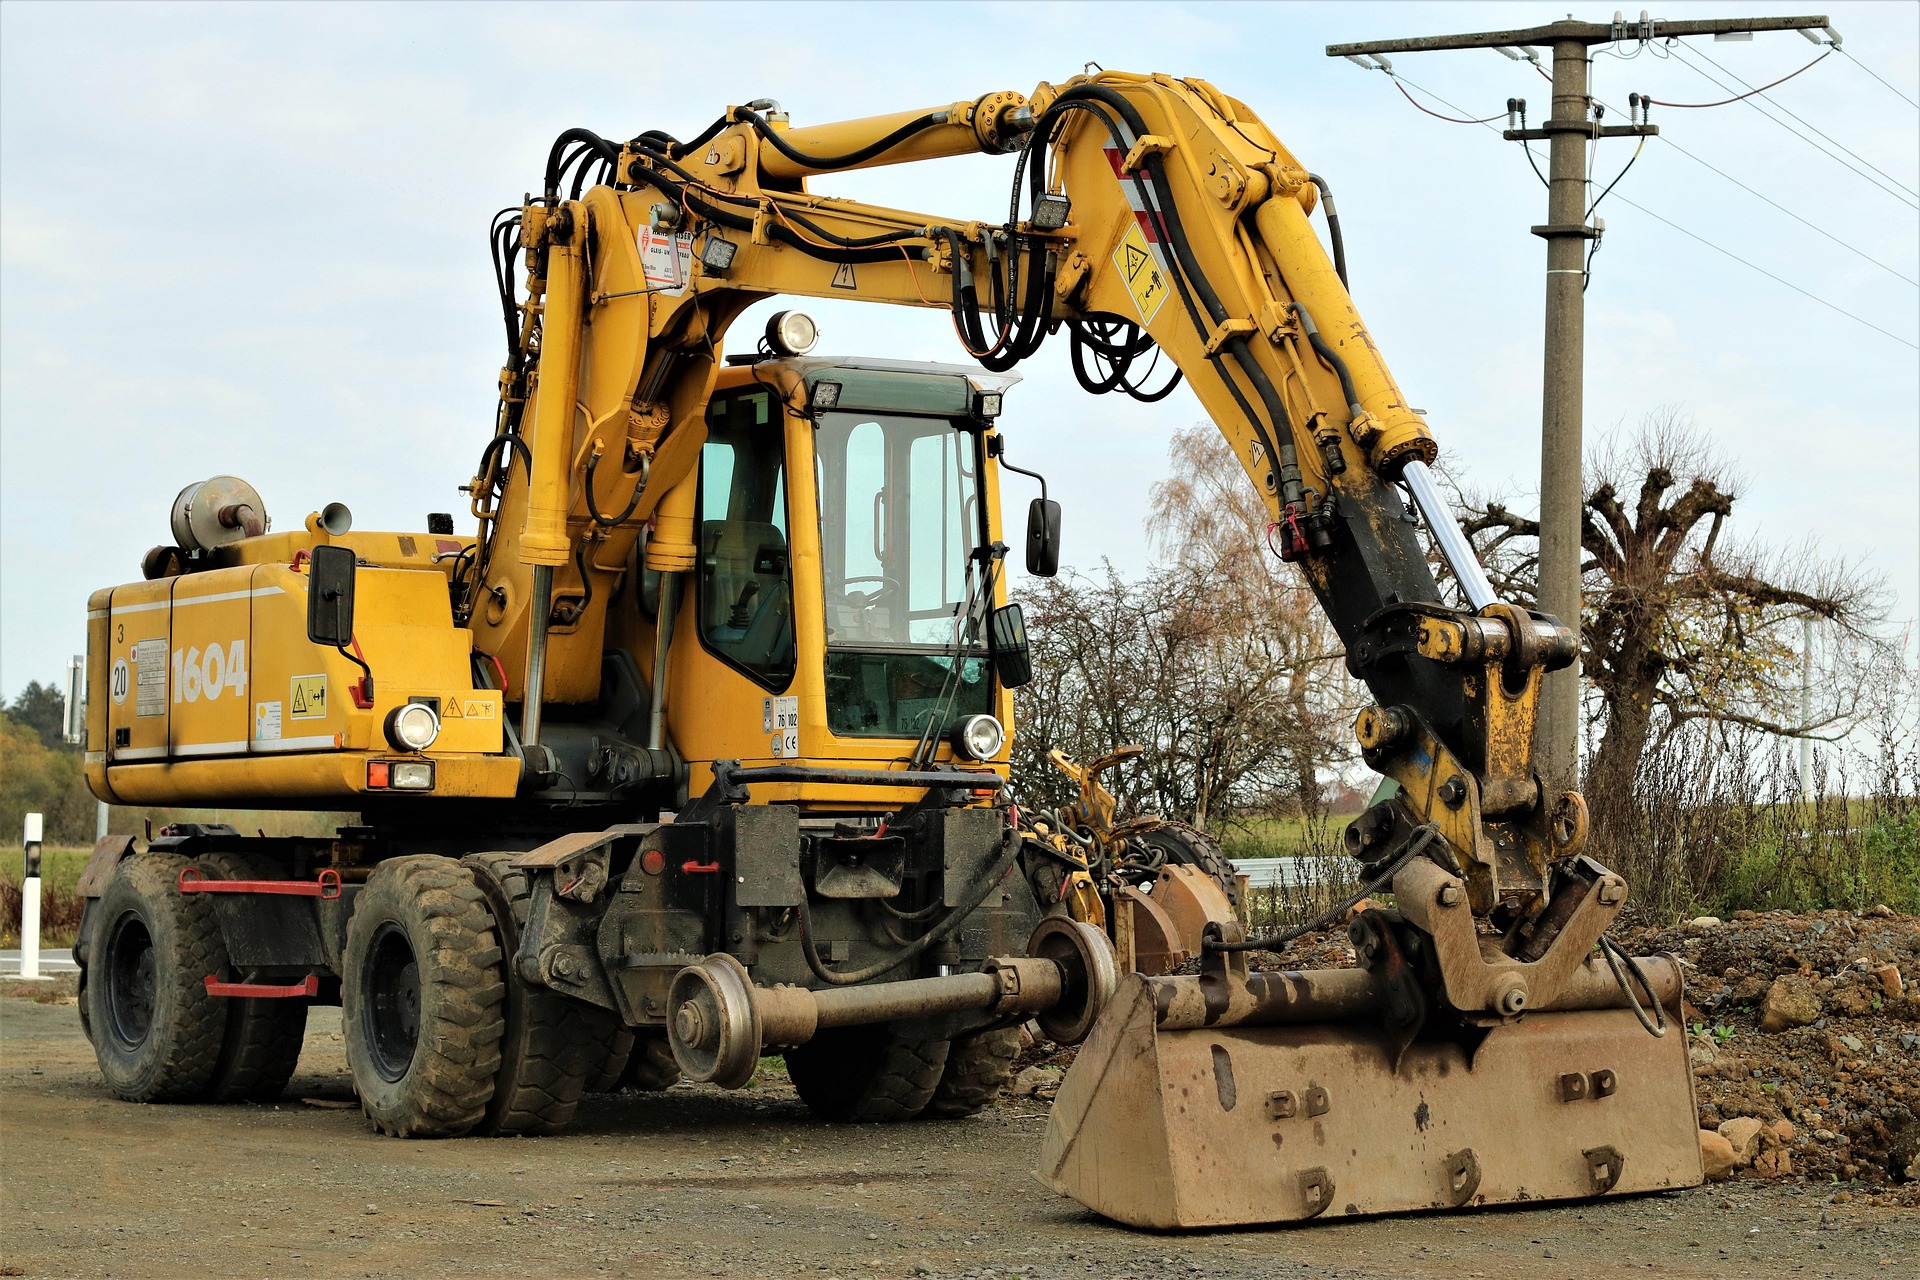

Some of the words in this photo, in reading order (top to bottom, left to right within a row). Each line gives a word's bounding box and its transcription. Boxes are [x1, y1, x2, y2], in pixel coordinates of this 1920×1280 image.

[117, 623, 124, 644] 3
[114, 666, 126, 696] 20
[173, 640, 247, 703] 1604
[778, 714, 785, 727] 76
[787, 713, 797, 727] 102
[785, 735, 796, 750] CE
